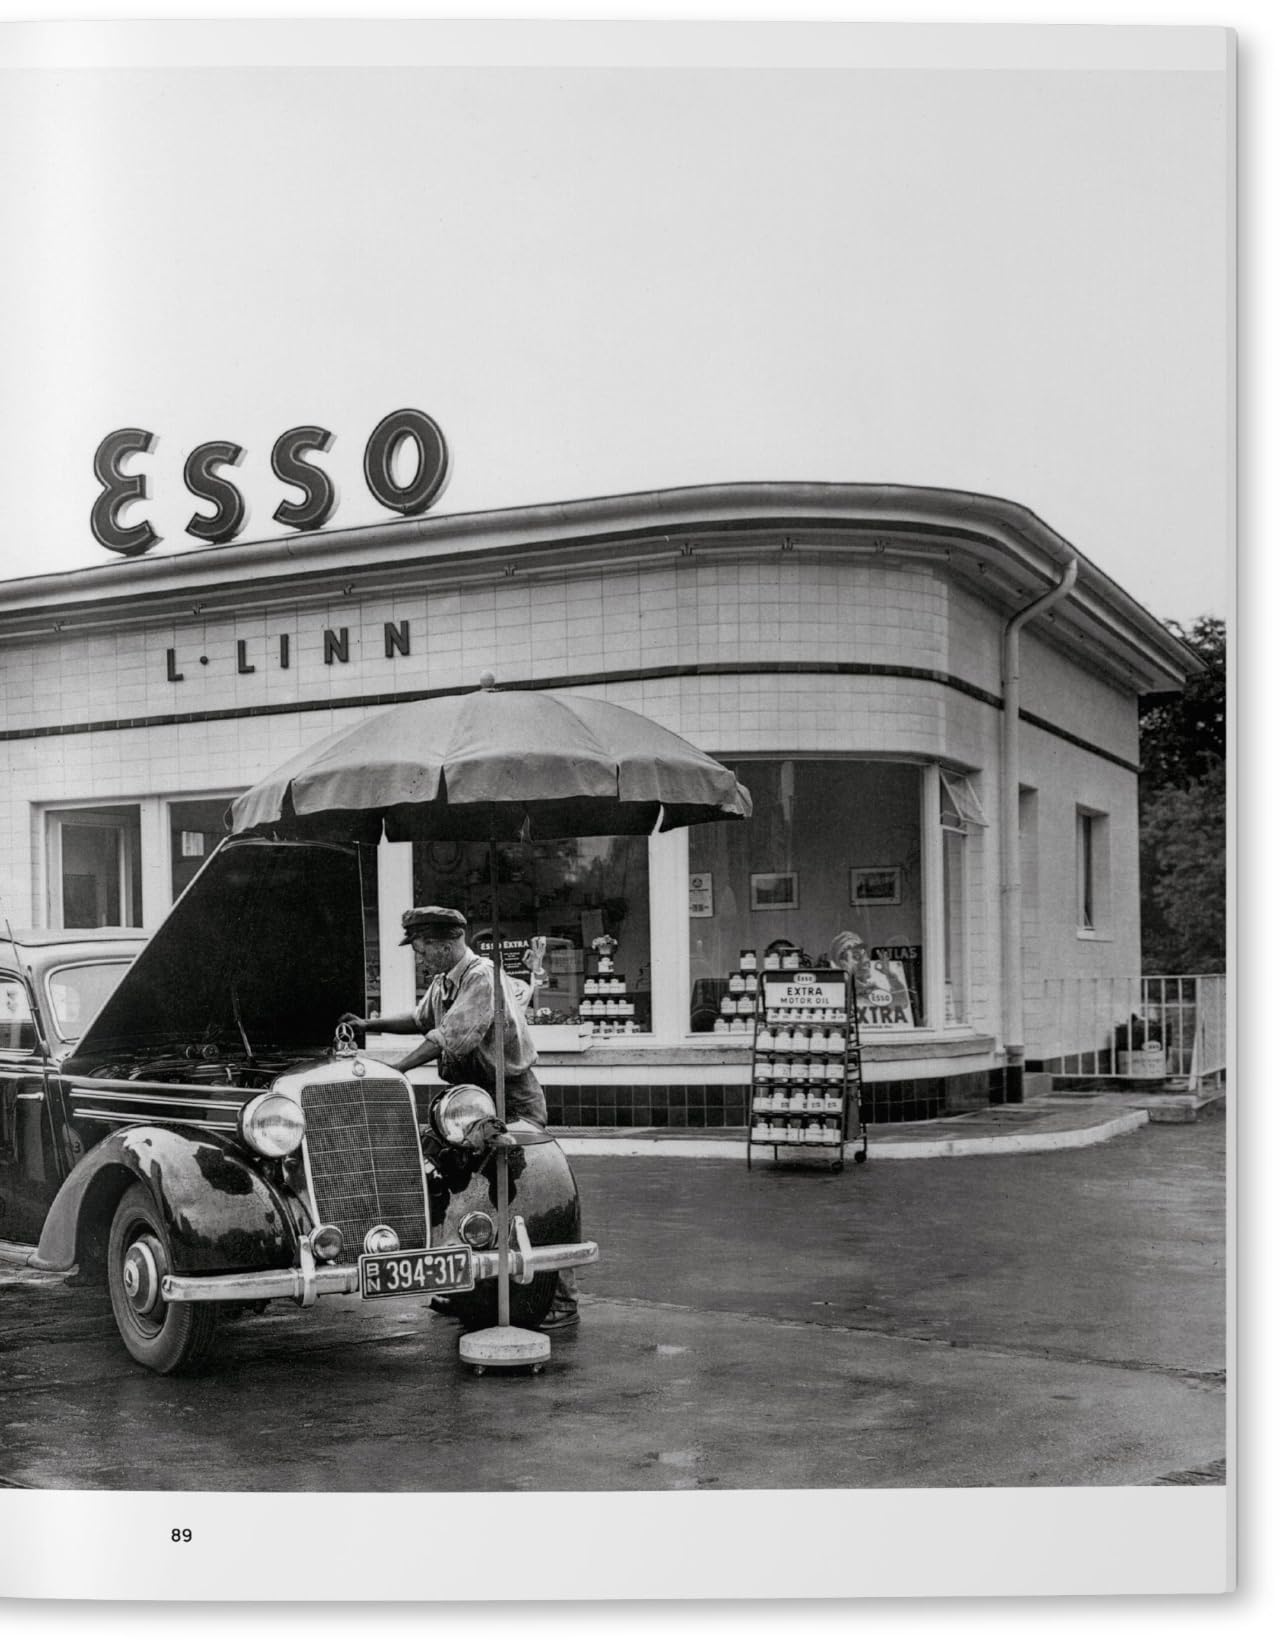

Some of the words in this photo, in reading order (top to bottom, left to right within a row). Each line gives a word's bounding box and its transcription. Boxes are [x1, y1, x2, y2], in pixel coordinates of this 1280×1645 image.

[90, 408, 450, 557] ESSO
[503, 940, 530, 949] EXTRA
[787, 987, 823, 996] EXTRA
[780, 997, 812, 1005] MOTOR
[815, 997, 830, 1005] OIL
[171, 1528, 193, 1543] 89
